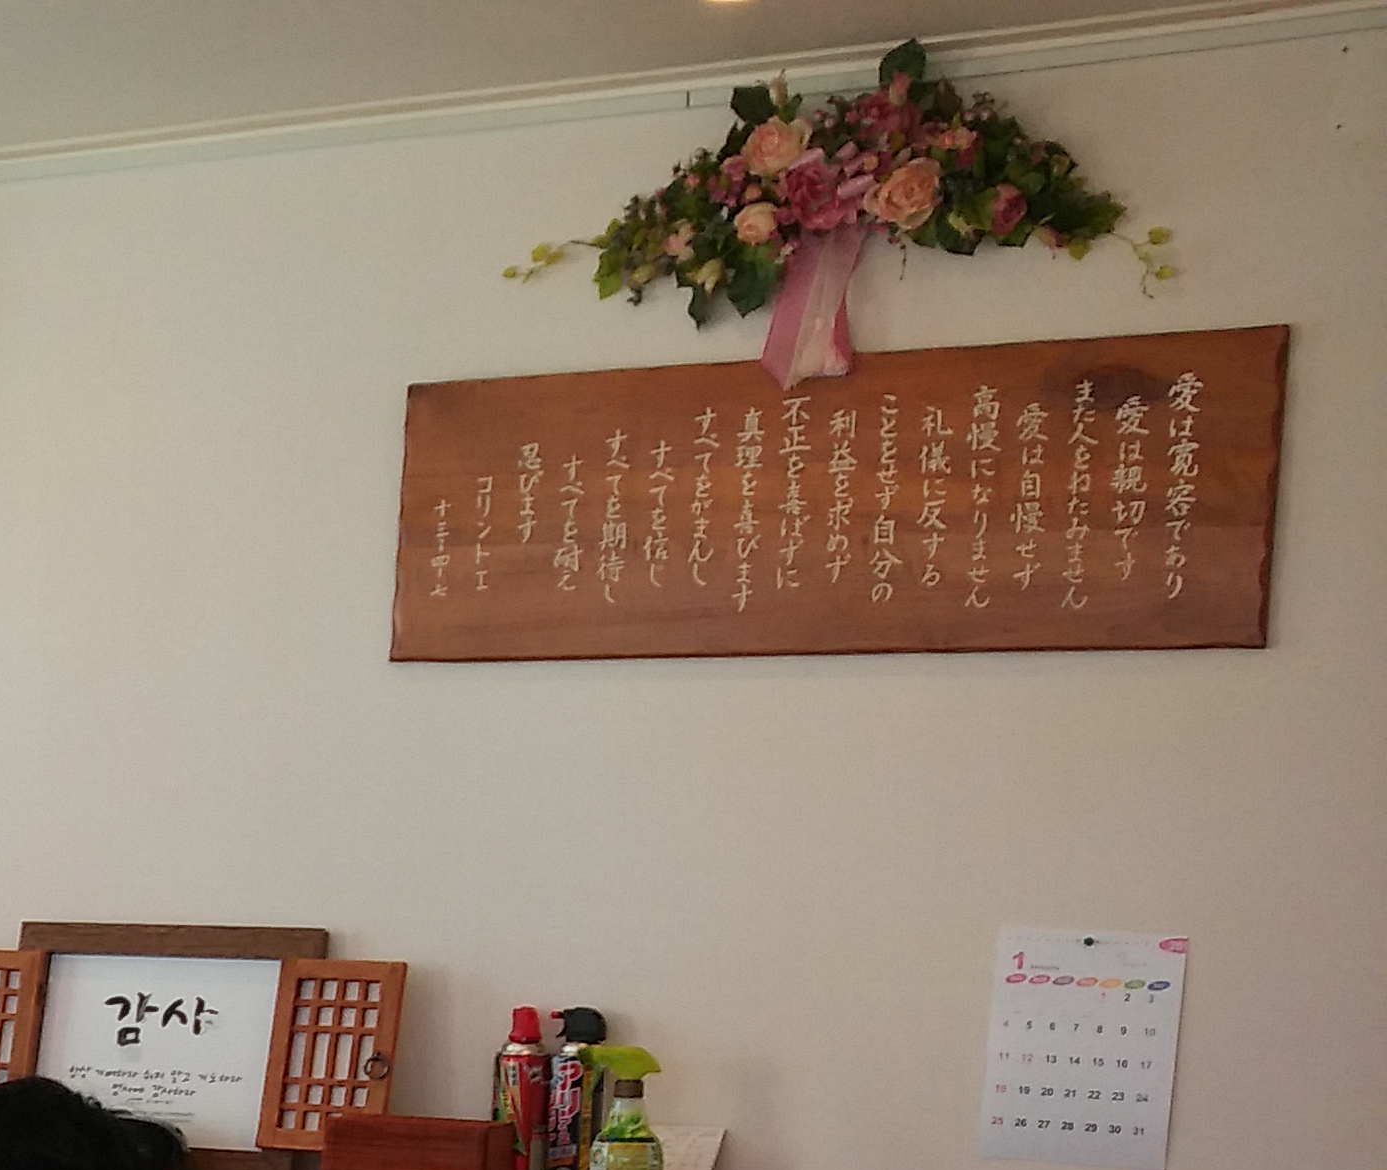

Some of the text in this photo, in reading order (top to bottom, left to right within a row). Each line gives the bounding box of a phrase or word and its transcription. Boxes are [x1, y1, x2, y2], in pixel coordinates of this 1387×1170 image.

[517, 442, 544, 543] 忍びます
[596, 428, 630, 603] すべてを期待し
[643, 439, 675, 588] すべてを信じ
[687, 406, 720, 586] すべてをがまんし
[732, 406, 765, 612] 真理を喜びます
[776, 396, 811, 589] 不正を喜ばずに
[825, 408, 858, 583] 利益を求めず
[869, 393, 902, 603] ことをせず自分の
[916, 406, 954, 587] 礼儀に反する
[965, 385, 1001, 608] 高慢になりません
[1010, 401, 1049, 590] 愛は自慢せず
[1061, 379, 1098, 609] また人をねたみません
[1110, 395, 1149, 581] 愛は親切です
[1166, 370, 1204, 600] 愛は寛容であり
[104, 992, 220, 1046] 감사
[1012, 951, 1025, 969] 1
[1026, 1020, 1033, 1029] 5
[1049, 1022, 1056, 1030] 6
[1073, 1023, 1080, 1031] 7
[1096, 1025, 1103, 1033] 8
[1120, 1026, 1127, 1035] 9
[1144, 1028, 1156, 1036] 10
[991, 1117, 1144, 1136] 25 26 27 28 29 30 31
[1018, 1086, 1030, 1094] 19
[1040, 1087, 1054, 1096] 20
[1064, 1089, 1076, 1098] 21
[1088, 1090, 1101, 1100] 22
[1111, 1092, 1125, 1101] 23
[1046, 1055, 1057, 1064] 13
[1069, 1056, 1081, 1065] 14
[1093, 1058, 1104, 1067] 15
[1116, 1059, 1128, 1068] 16
[1140, 1061, 1152, 1069] 17
